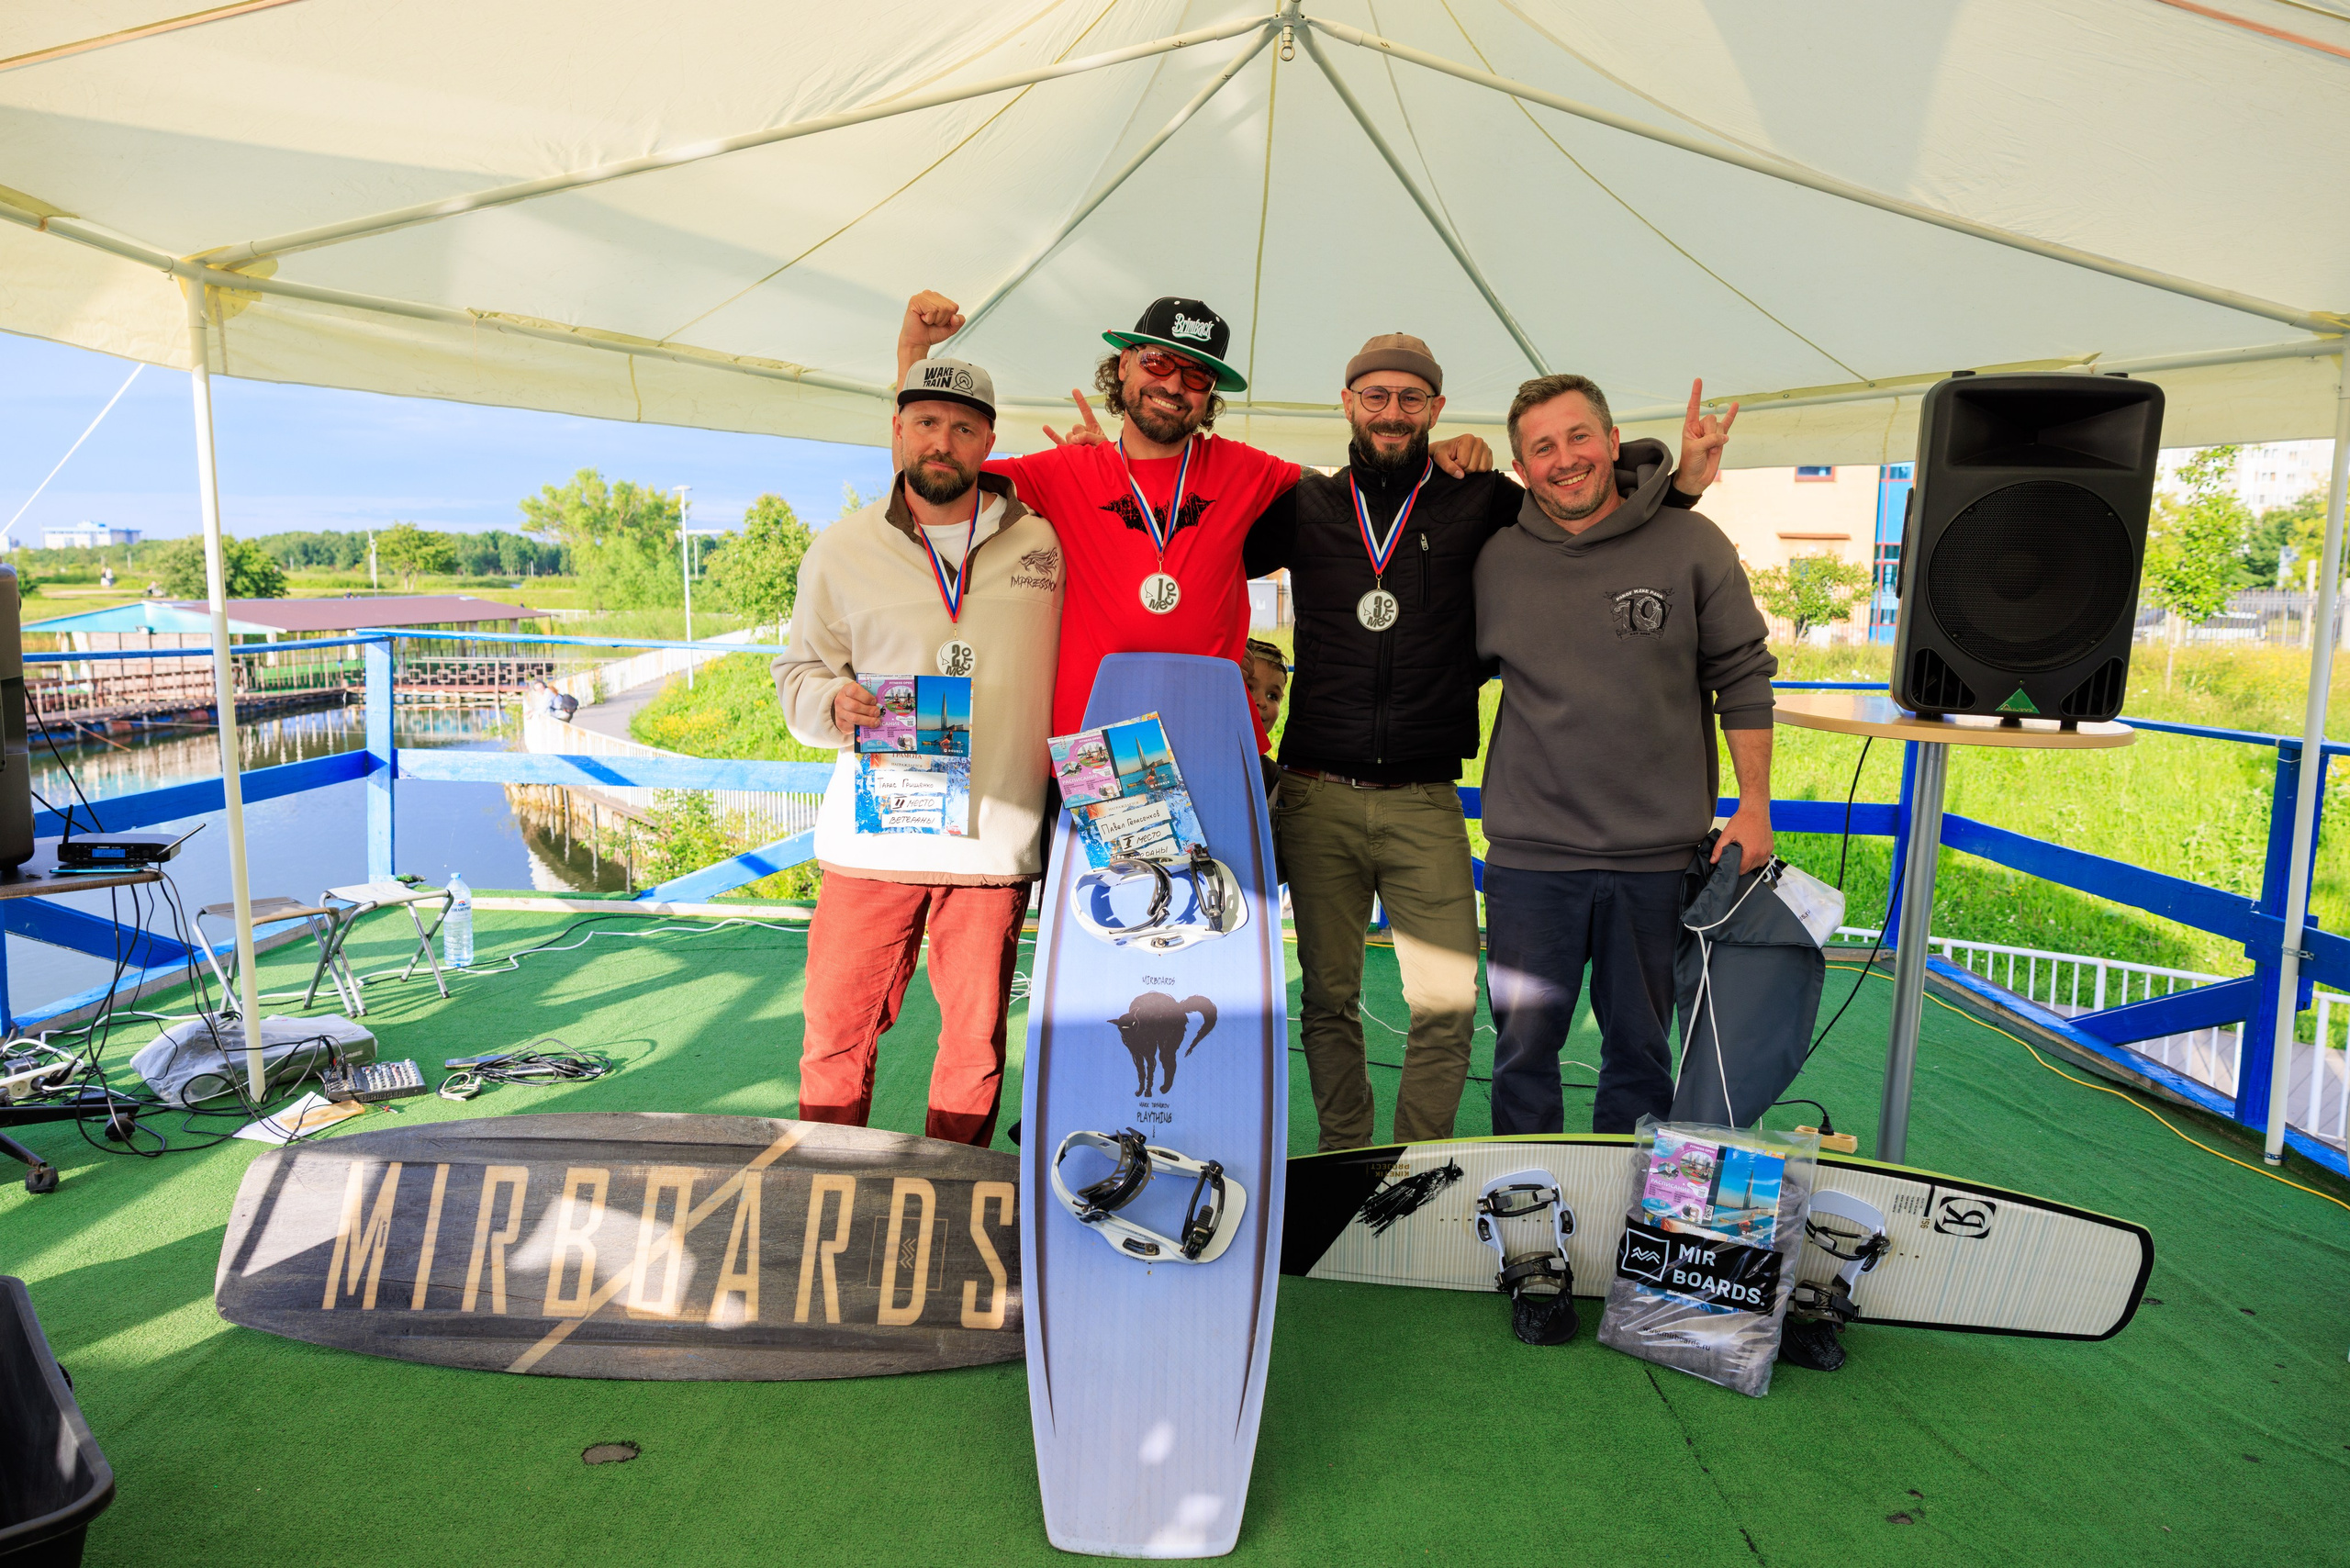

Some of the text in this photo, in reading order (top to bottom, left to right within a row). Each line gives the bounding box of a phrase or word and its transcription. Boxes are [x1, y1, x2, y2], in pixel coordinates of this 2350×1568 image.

[923, 376, 953, 387] TRAIN
[924, 367, 954, 380] WAKE
[1158, 578, 1163, 600] 1
[1373, 596, 1382, 618] 3
[952, 644, 960, 666] 2
[1062, 774, 1098, 784] РАСПИСАНИЕ
[1142, 975, 1175, 985] MIRBOARDS
[1136, 1111, 1172, 1124] PLAYTHING
[1651, 1178, 1689, 1193] РАСПИСАНИЕ
[322, 1161, 1014, 1329] MIRBOARDS
[1679, 1244, 1717, 1267] MIR
[1673, 1269, 1765, 1306] BOARDS.
